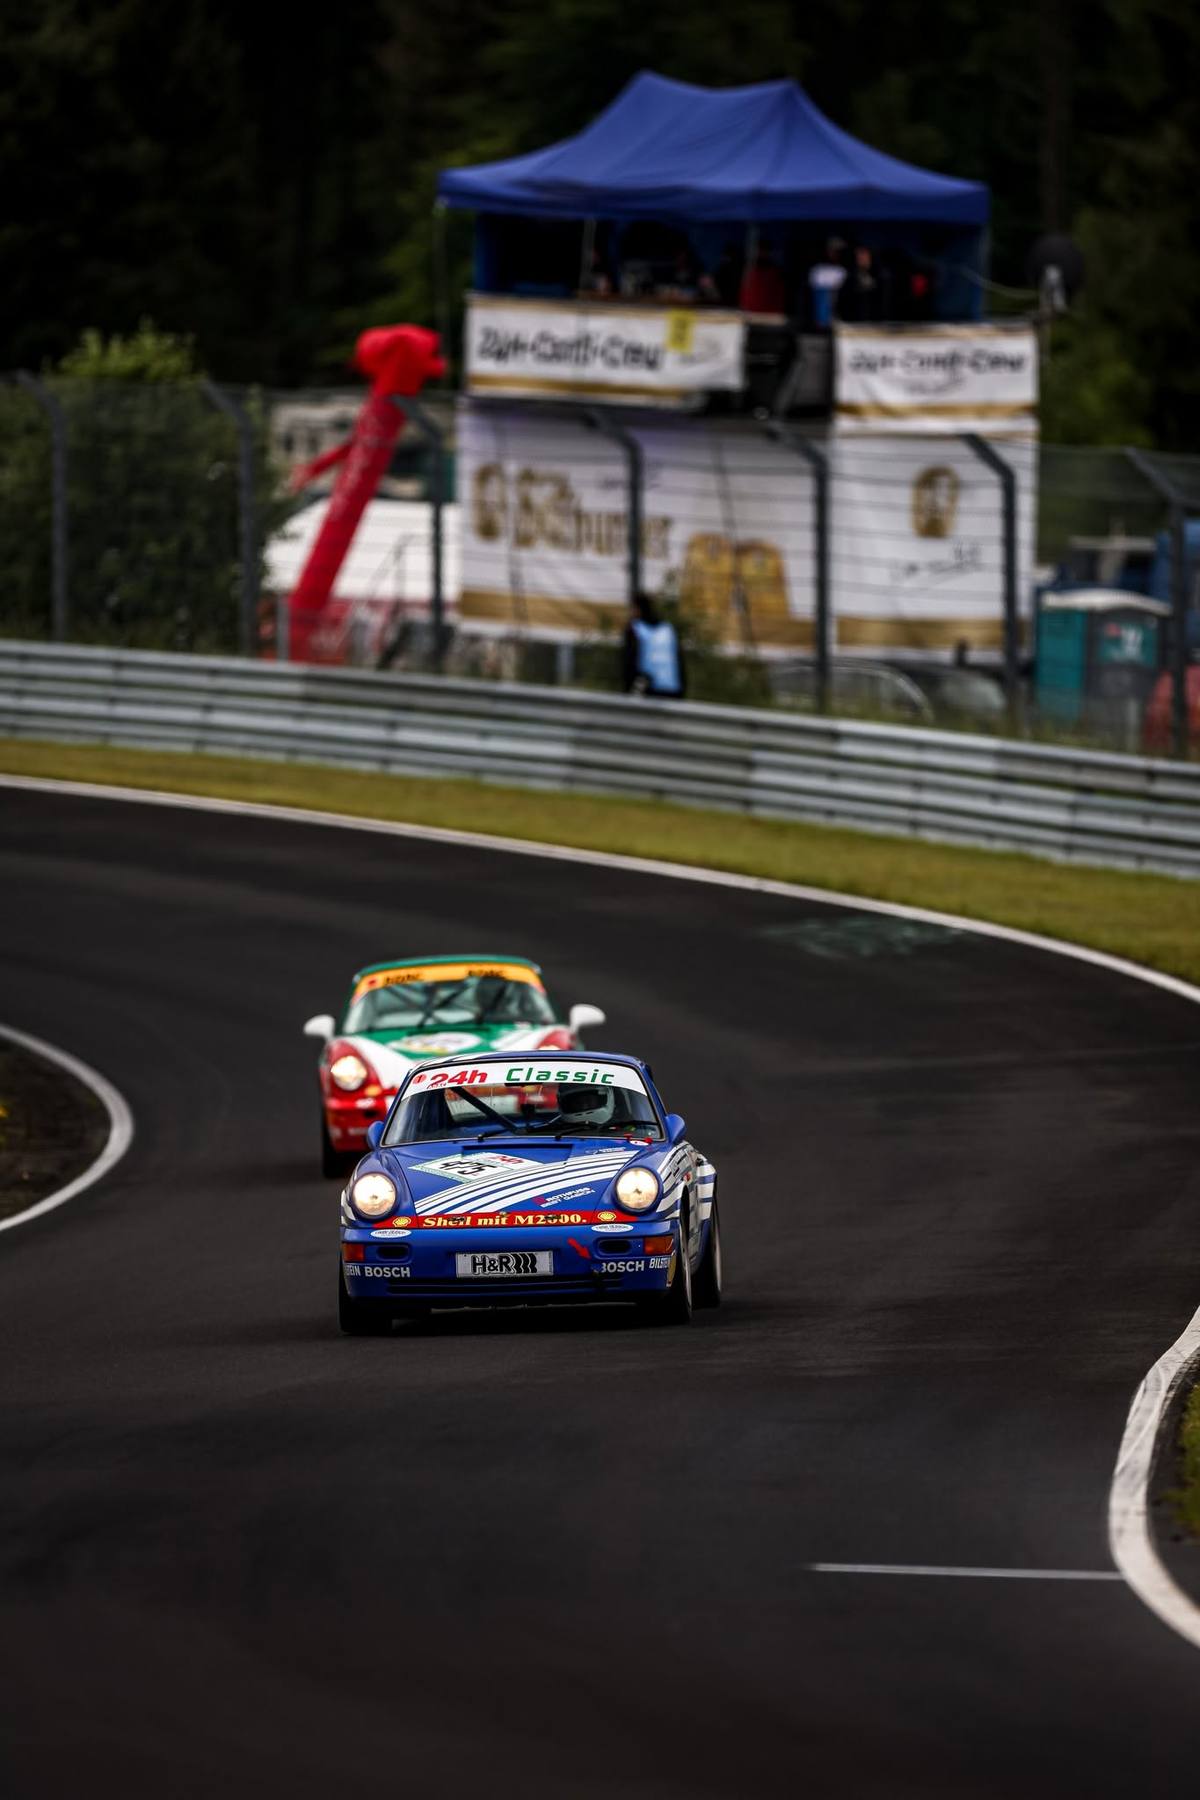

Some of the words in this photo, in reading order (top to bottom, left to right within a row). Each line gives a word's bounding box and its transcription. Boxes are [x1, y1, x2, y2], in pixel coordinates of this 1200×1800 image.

[427, 1070, 488, 1089] 24h
[505, 1067, 615, 1084] Classic
[477, 1215, 508, 1226] mit
[364, 1266, 410, 1278] BOSCH
[601, 1260, 645, 1272] BOSCH
